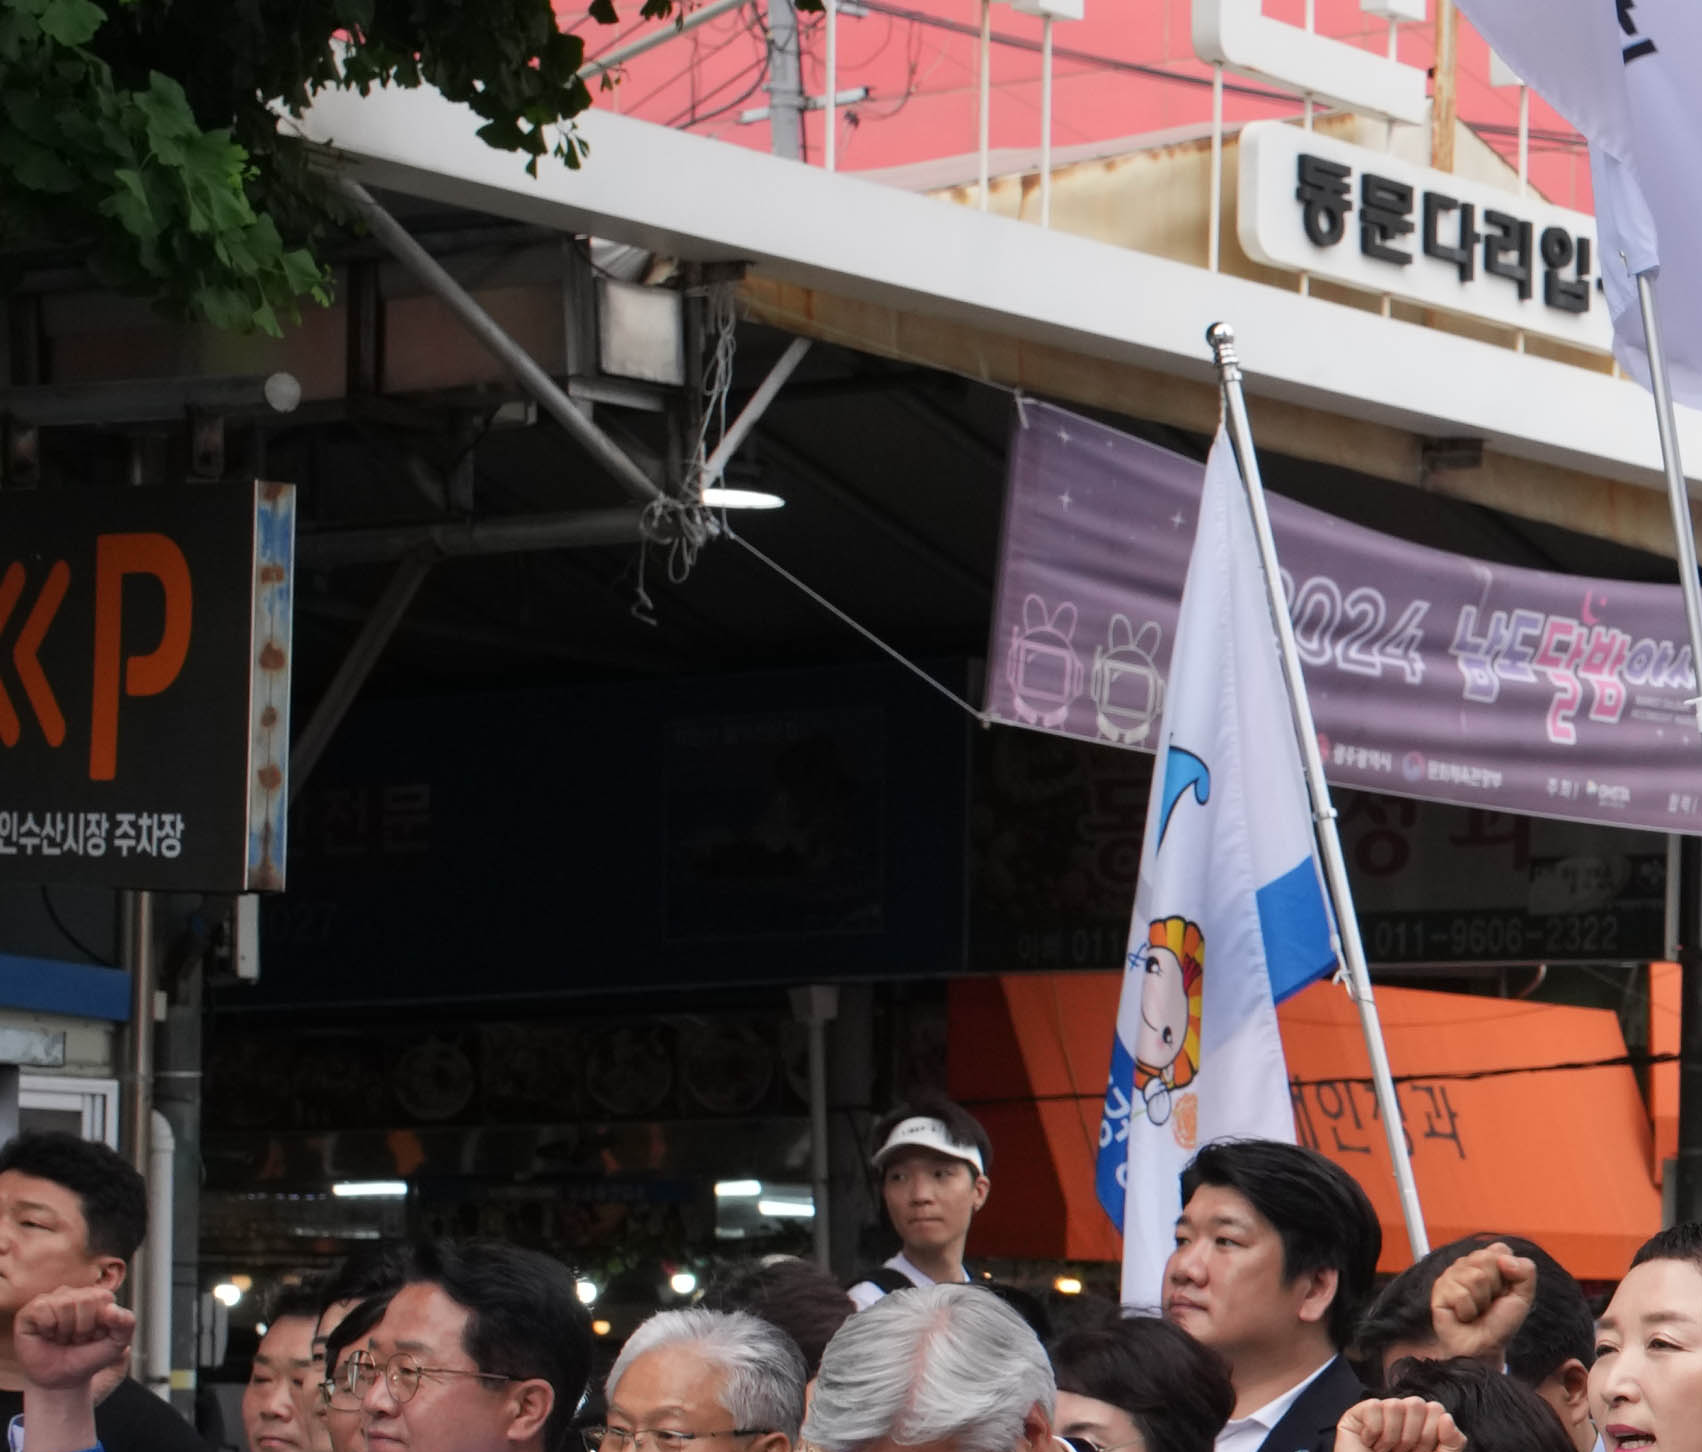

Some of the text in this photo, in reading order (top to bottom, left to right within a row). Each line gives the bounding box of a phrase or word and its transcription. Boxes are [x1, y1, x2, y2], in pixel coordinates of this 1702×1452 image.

[1297, 153, 1602, 314] 동문다리입
[1270, 573, 1430, 685] 024
[114, 812, 185, 858] 주차장
